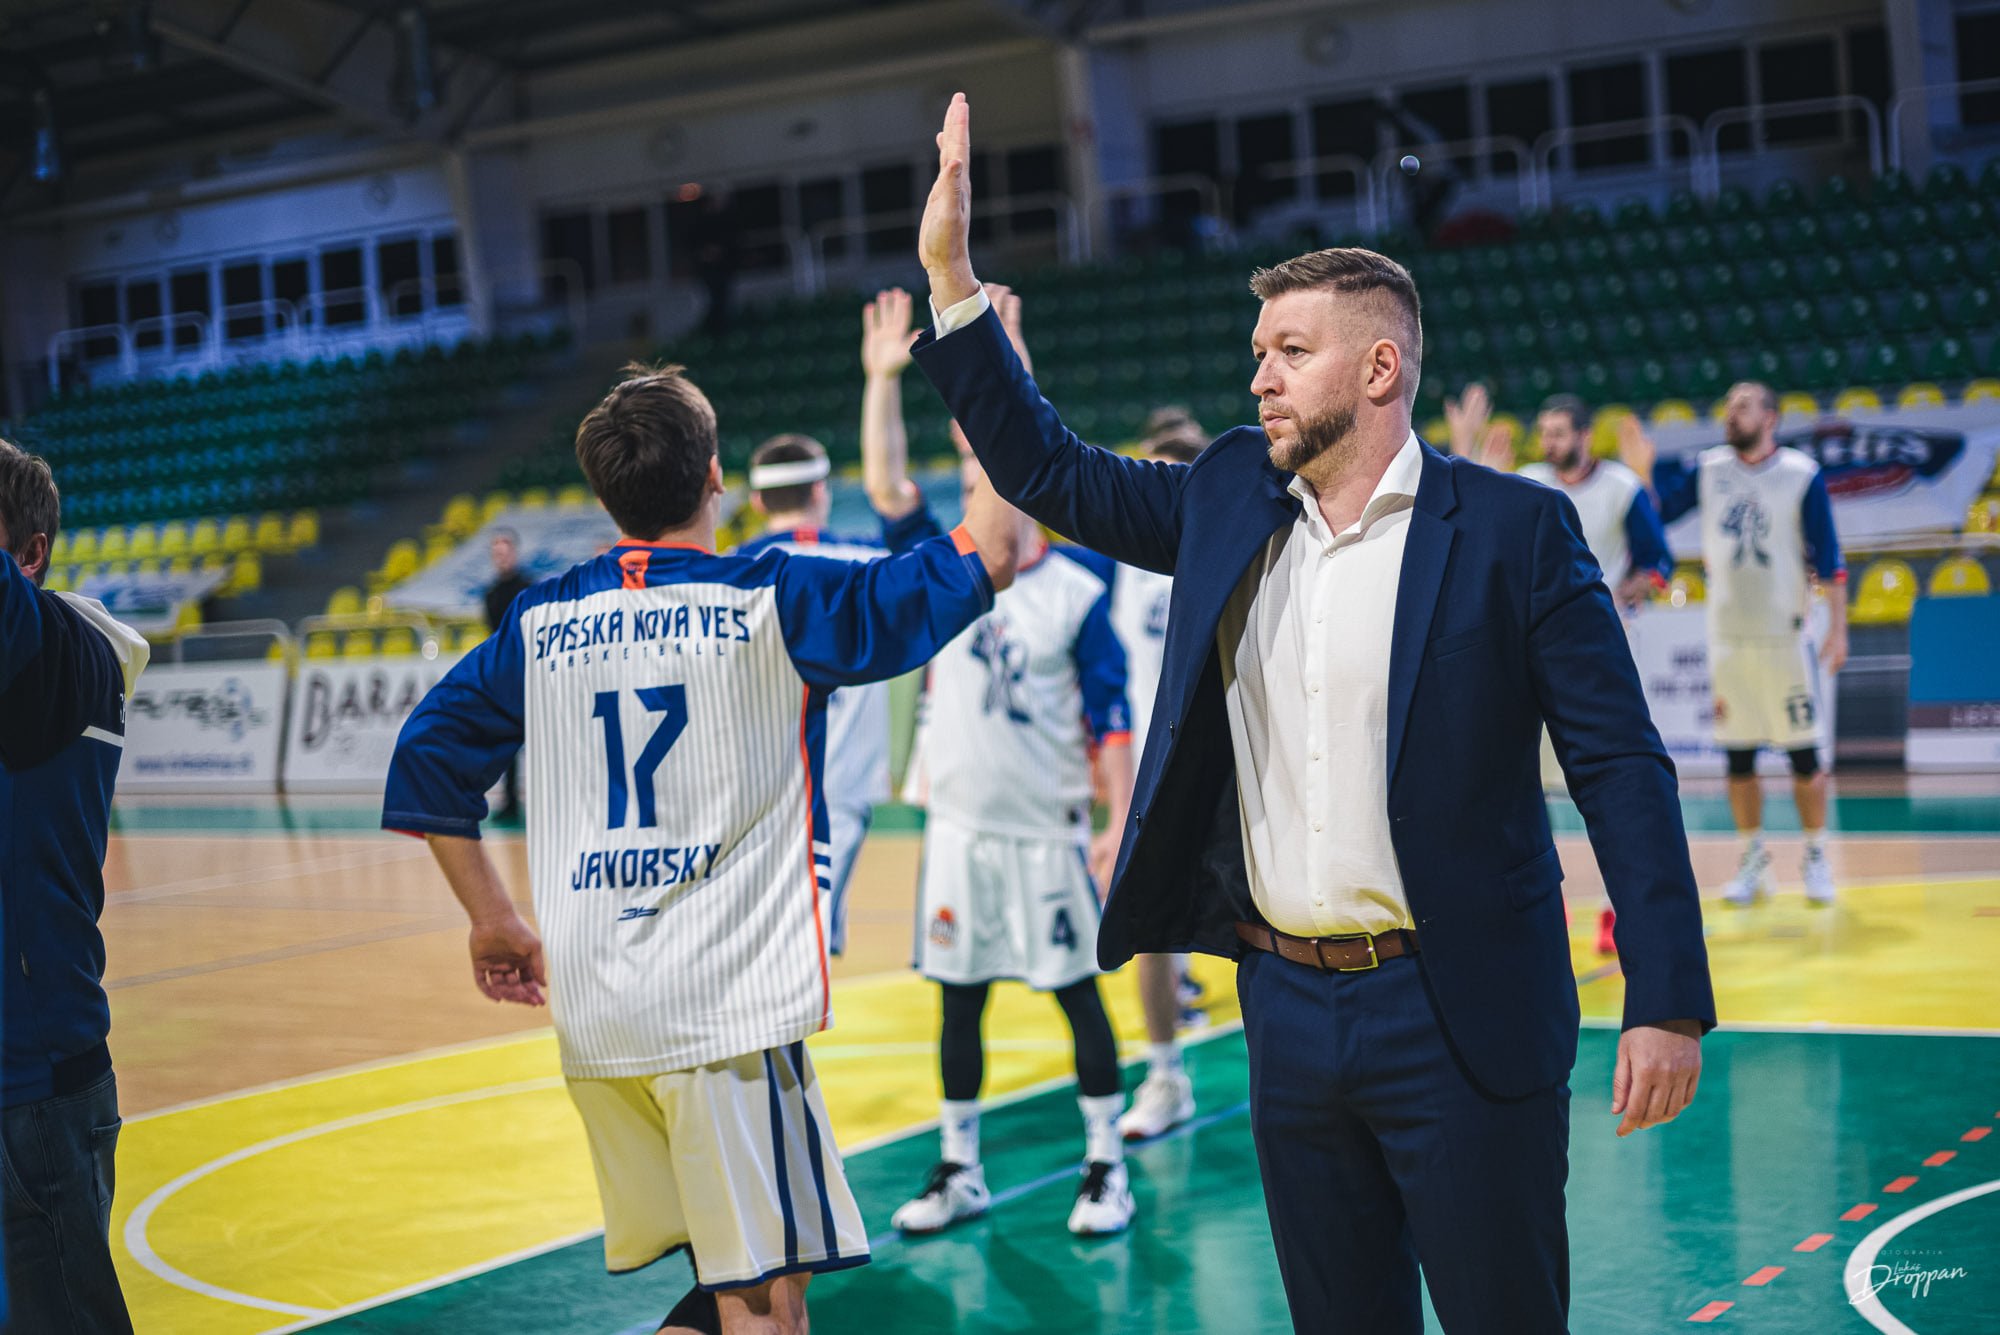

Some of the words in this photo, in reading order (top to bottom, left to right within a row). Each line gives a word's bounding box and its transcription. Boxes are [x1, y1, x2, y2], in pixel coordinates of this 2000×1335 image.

[698, 605, 751, 643] VES
[550, 642, 725, 672] BASKETBALL
[301, 668, 437, 754] DARA
[592, 683, 689, 830] 17
[572, 843, 722, 891] JAVORSKY
[1052, 905, 1077, 951] 4
